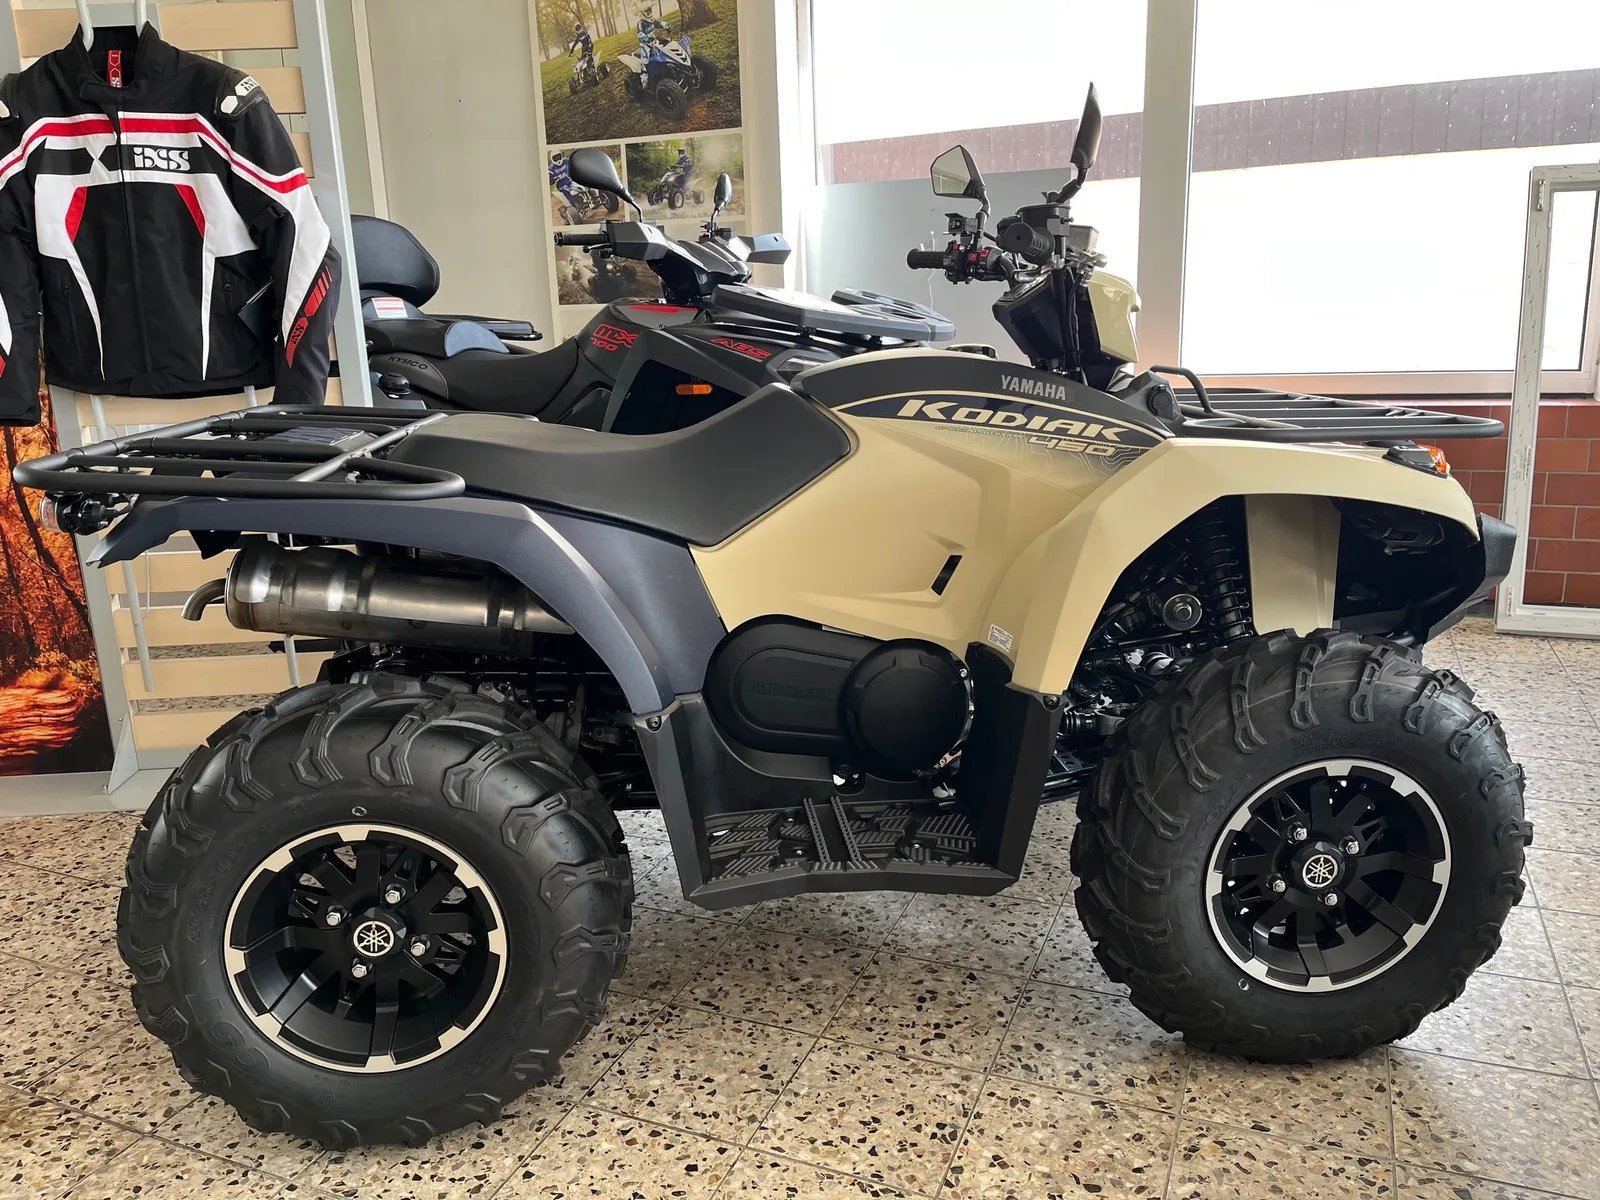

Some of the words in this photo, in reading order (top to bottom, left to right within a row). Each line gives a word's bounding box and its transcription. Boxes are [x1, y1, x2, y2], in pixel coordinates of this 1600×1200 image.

[590, 336, 618, 352] 700
[710, 338, 772, 360] ABS
[387, 355, 429, 370] KYMCO
[1000, 374, 1067, 401] YAMAHA
[896, 398, 1130, 443] KODIAK
[1027, 434, 1118, 458] 450
